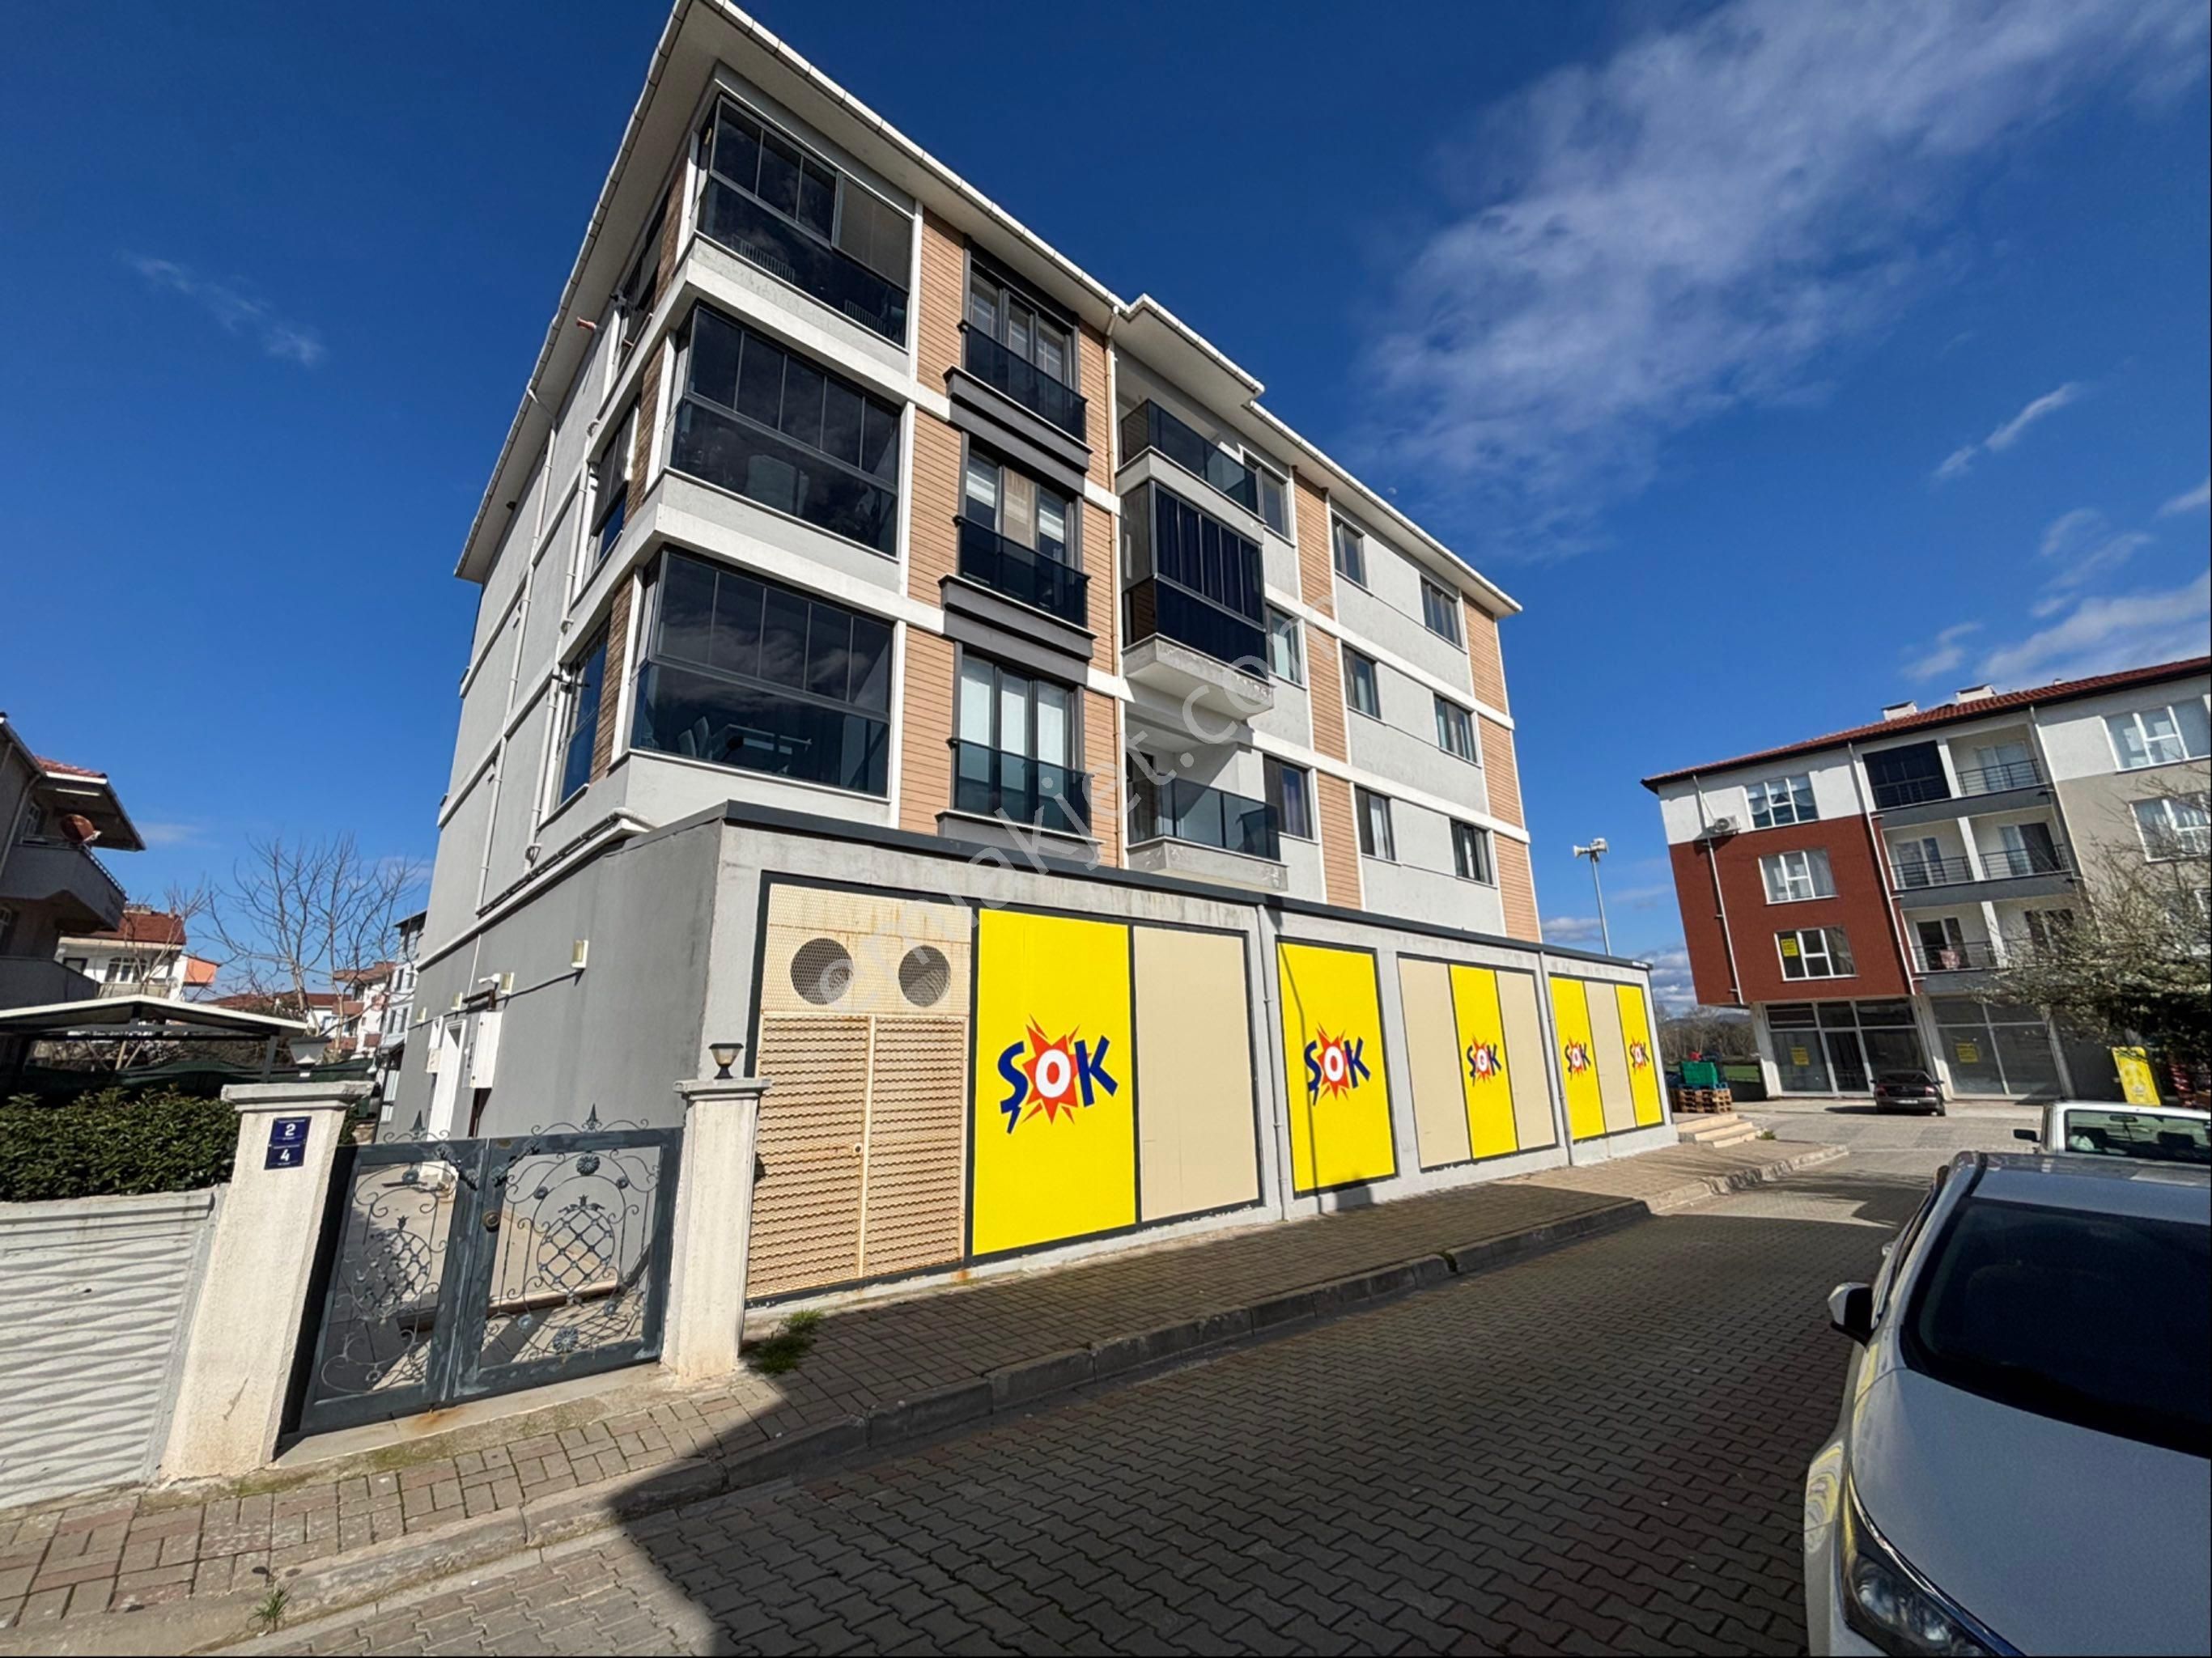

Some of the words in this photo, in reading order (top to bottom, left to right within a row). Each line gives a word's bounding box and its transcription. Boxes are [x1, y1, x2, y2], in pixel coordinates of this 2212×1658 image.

[1304, 1036, 1371, 1106] ŞOK
[1467, 1042, 1502, 1088] ŞOK
[1565, 1042, 1591, 1080] ŞOK
[997, 1035, 1119, 1134] ŞOK
[285, 1123, 296, 1136] 2
[280, 1148, 290, 1161] 4
